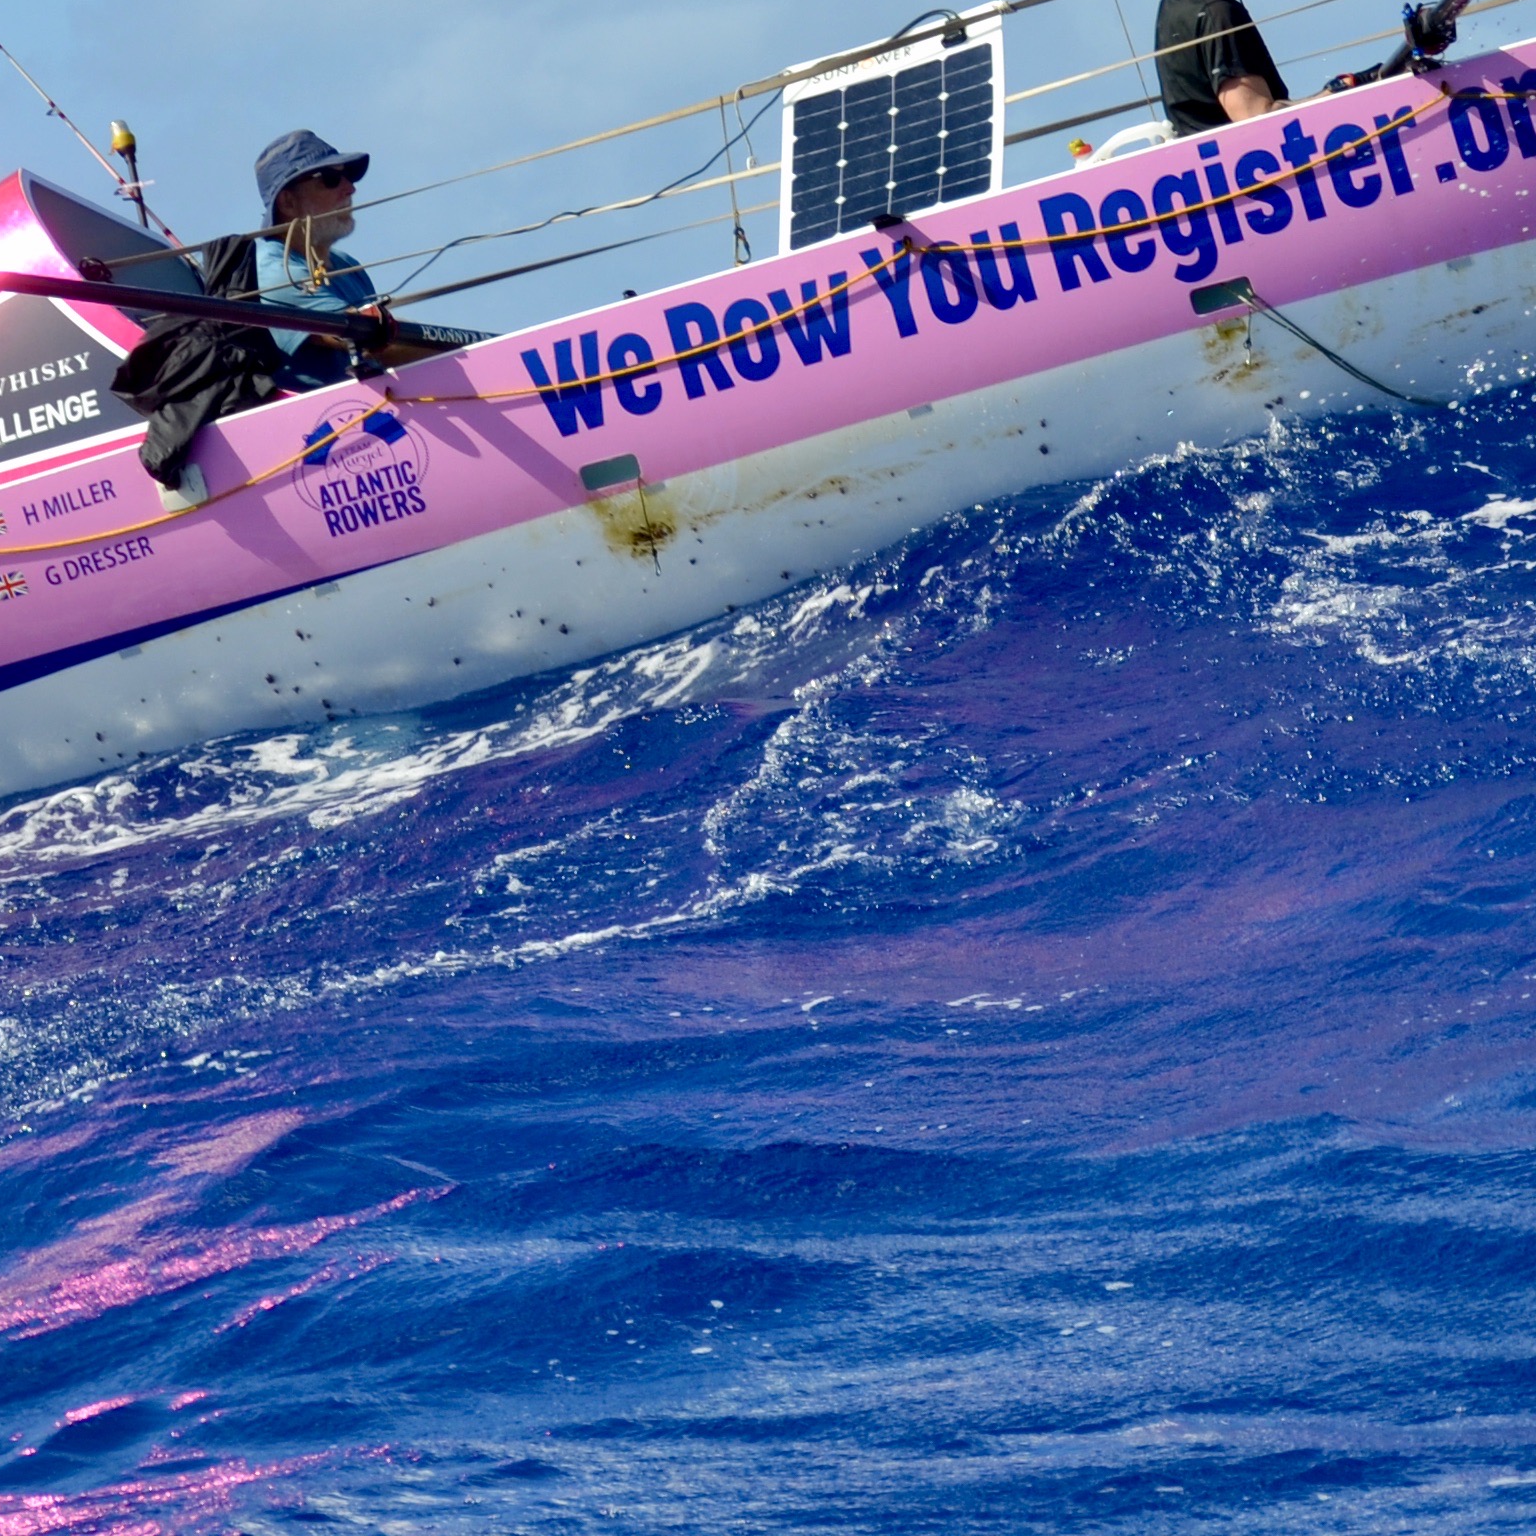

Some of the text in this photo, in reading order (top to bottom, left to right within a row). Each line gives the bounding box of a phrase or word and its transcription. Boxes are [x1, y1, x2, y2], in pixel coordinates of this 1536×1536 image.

[520, 329, 663, 437] We
[663, 273, 852, 401] Row
[859, 222, 1038, 339] You
[22, 479, 118, 526] H MILLER
[319, 460, 416, 509] ATLANTIC
[324, 486, 426, 537] ROWERS
[44, 536, 155, 586] G DRESSER
